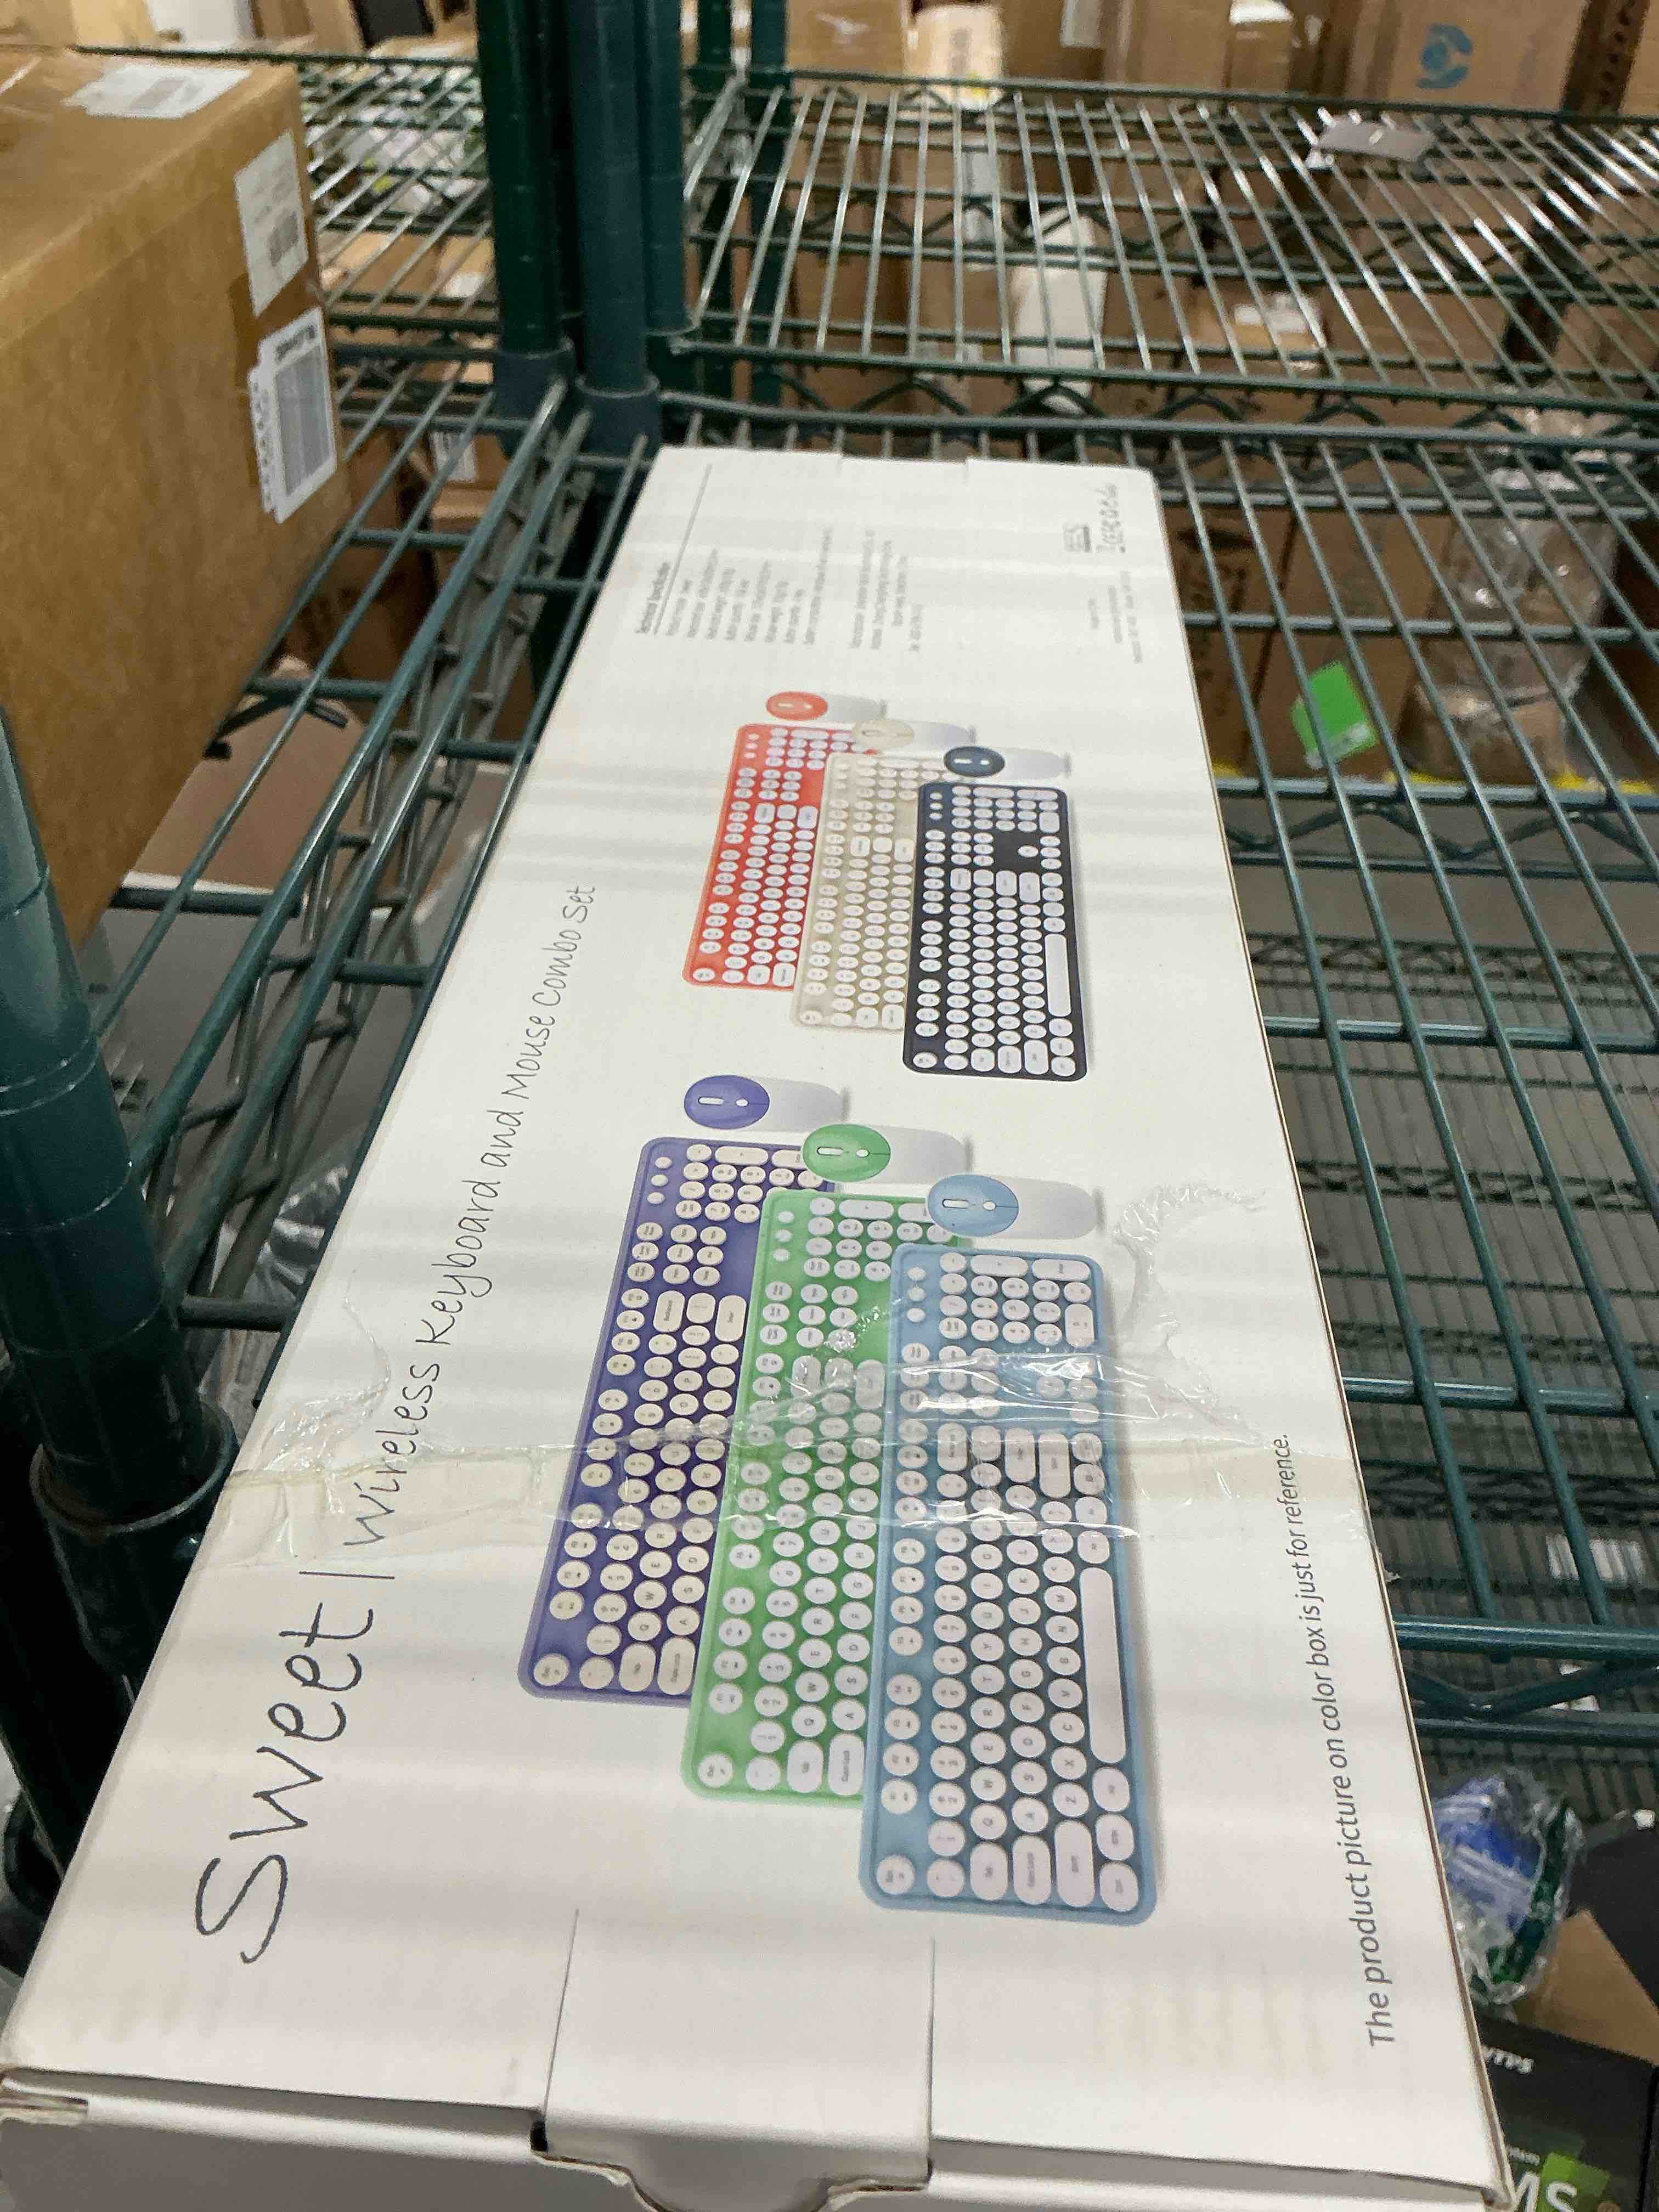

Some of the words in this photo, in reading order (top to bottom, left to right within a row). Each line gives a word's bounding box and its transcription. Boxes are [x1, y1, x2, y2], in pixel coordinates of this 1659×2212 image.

[562, 886, 595, 923] Set
[532, 930, 581, 1006] Combo
[501, 1016, 555, 1099] Mouse
[481, 1110, 523, 1167] and
[415, 1181, 500, 1345] Keyboard
[343, 1363, 440, 1546] Wireless
[1273, 1435, 1304, 1524] reference.
[1285, 1529, 1309, 1557] for
[1291, 1562, 1324, 1603] just
[639, 1623, 650, 1632] Q
[645, 1592, 654, 1601] W
[1019, 1607, 1029, 1616] J
[1056, 1594, 1065, 1602] M
[982, 1611, 992, 1620] U
[1299, 1605, 1321, 1621] is
[983, 1641, 992, 1650] Y
[1020, 1637, 1030, 1646] H
[1306, 1627, 1330, 1667] box
[807, 1683, 817, 1692] W
[1062, 1690, 1071, 1698] V
[1312, 1672, 1341, 1731] color
[803, 1718, 815, 1726] Q
[1062, 1723, 1073, 1731] C
[1022, 1737, 1034, 1746] D
[1327, 1739, 1347, 1768] on
[194, 1602, 374, 1965] Sweet
[983, 1779, 994, 1789] W
[1065, 1796, 1076, 1804] Z
[982, 1818, 994, 1827] Q
[1025, 1812, 1035, 1820] A
[1333, 1776, 1372, 1865] picture
[1345, 1873, 1392, 1984] product
[1365, 1993, 1395, 2047] The
